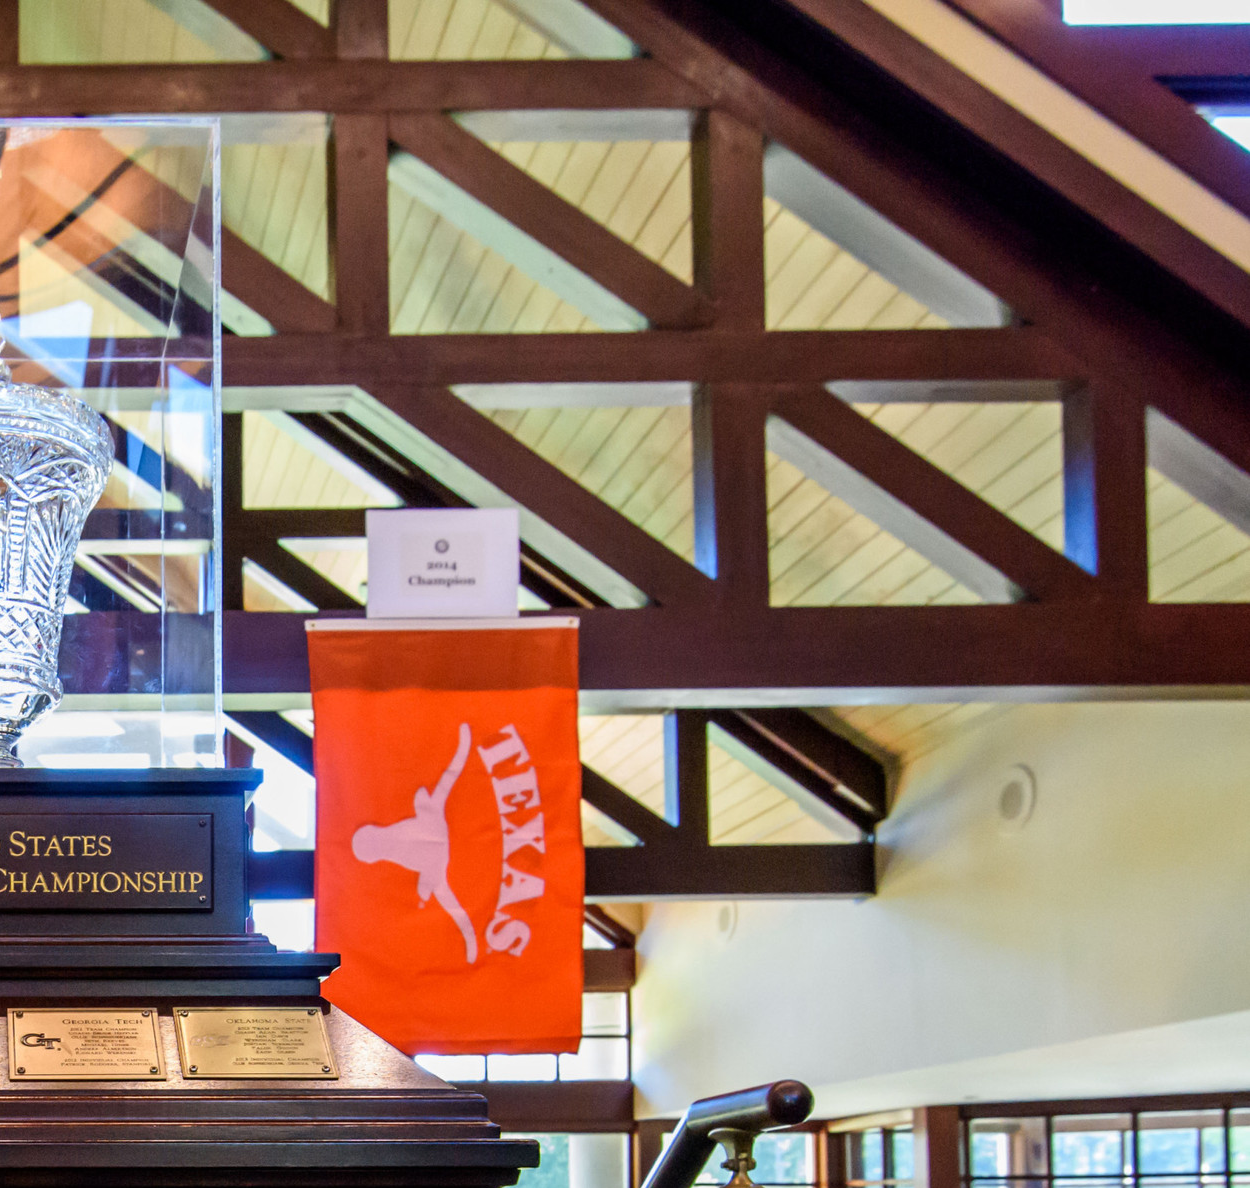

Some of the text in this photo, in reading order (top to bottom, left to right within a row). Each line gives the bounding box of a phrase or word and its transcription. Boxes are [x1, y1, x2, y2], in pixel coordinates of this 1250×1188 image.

[426, 561, 458, 571] 2014
[408, 576, 476, 588] Champion
[9, 831, 112, 858] STATES
[477, 723, 545, 957] TEXAS
